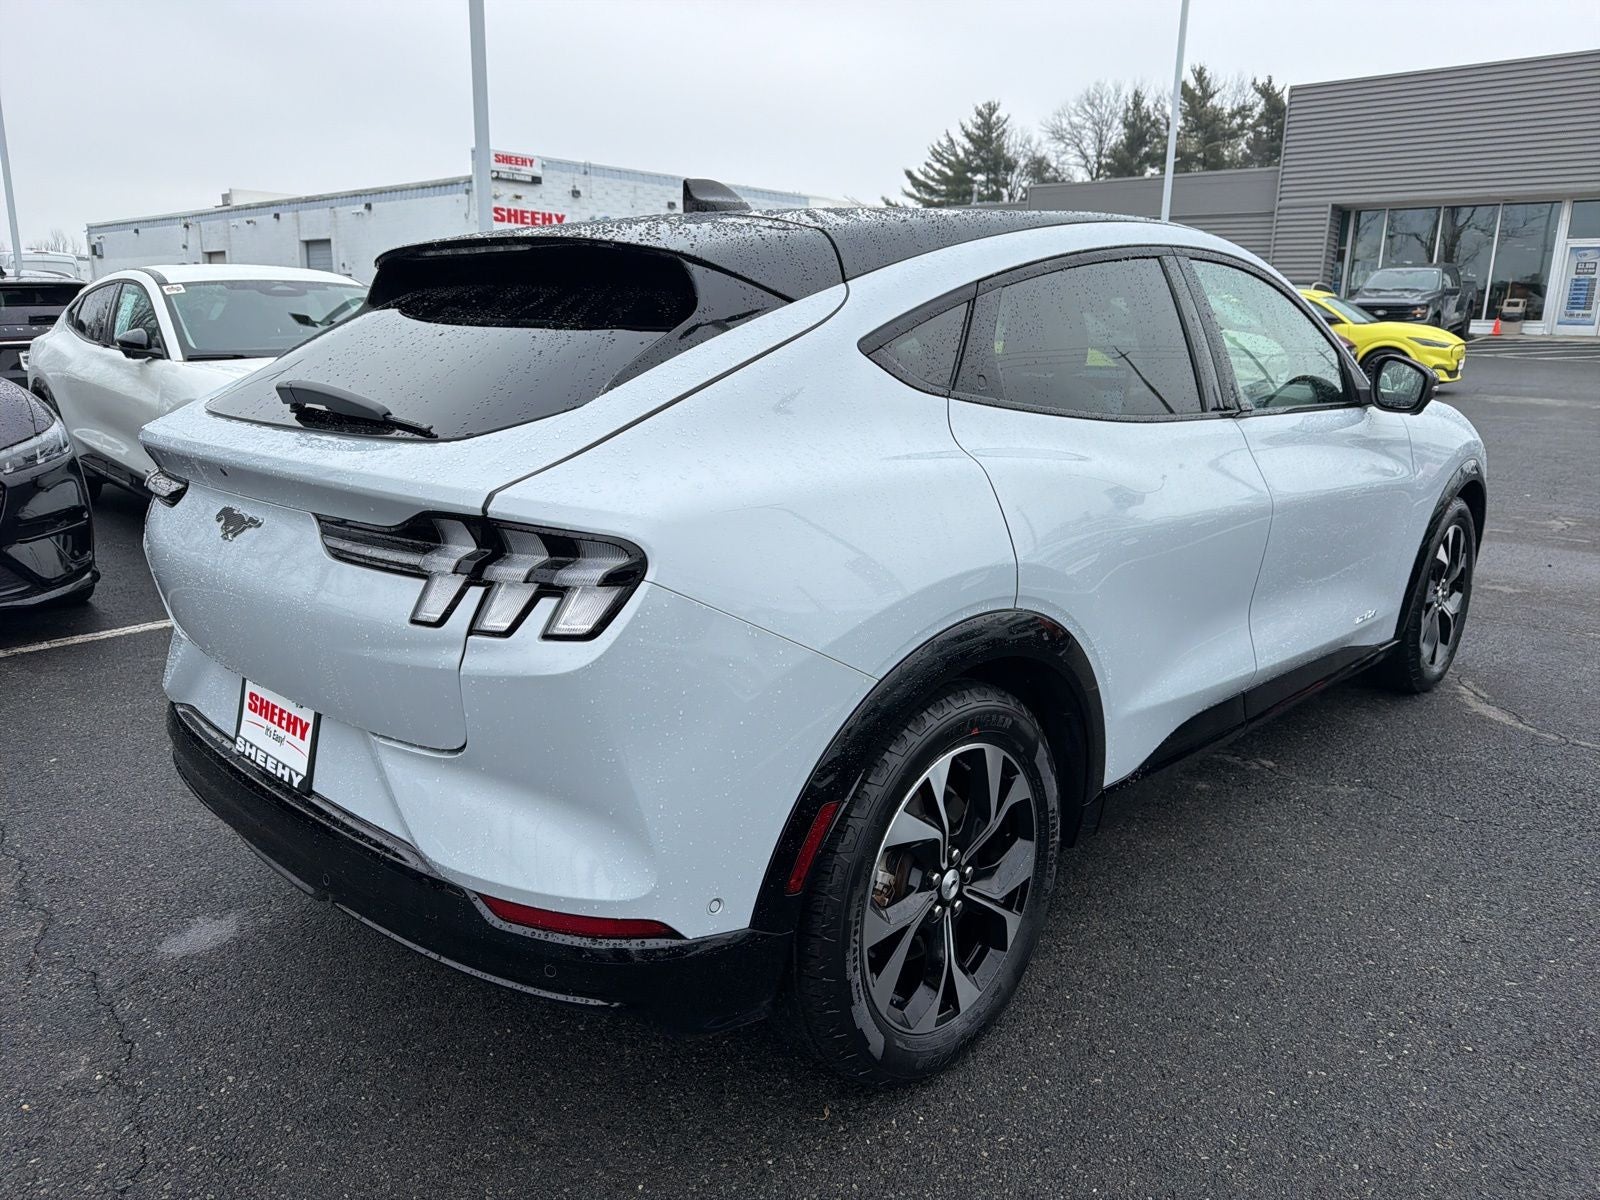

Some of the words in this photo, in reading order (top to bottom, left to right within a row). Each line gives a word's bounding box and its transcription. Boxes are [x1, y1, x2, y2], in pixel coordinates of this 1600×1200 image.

[494, 153, 534, 168] SHEEHY
[492, 206, 566, 226] SHEEHY
[248, 691, 311, 742] SHEEHY
[264, 725, 272, 738] It's
[272, 729, 286, 747] Easy!
[235, 736, 304, 788] SHEEHY
